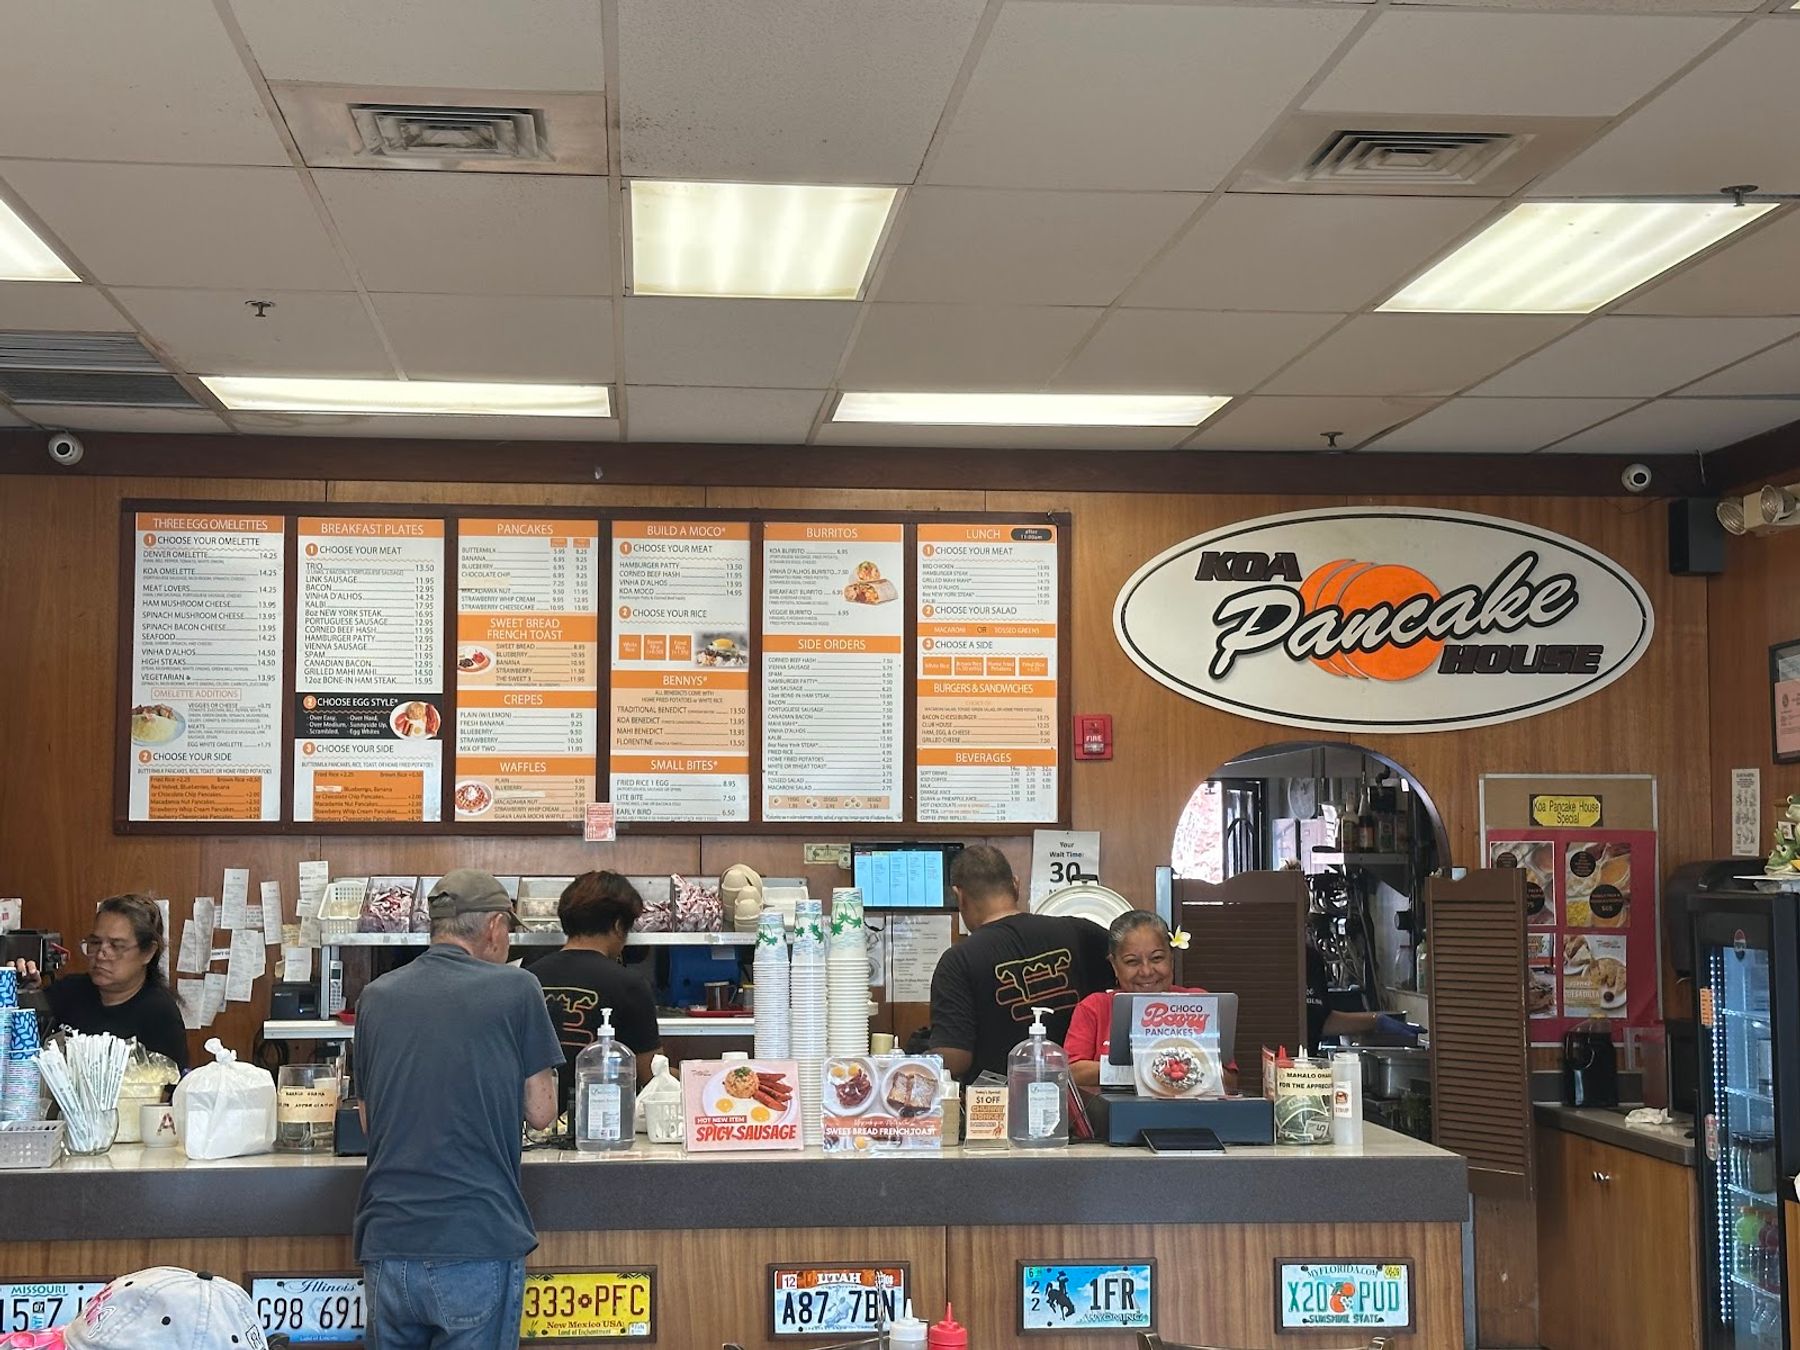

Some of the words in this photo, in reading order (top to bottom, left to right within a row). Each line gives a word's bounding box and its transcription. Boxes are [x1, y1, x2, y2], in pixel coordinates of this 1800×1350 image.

[153, 518, 186, 529] THREE
[187, 519, 208, 530] EGG
[209, 519, 268, 530] OMELETTES
[321, 523, 382, 535] BREAKFAST
[384, 524, 424, 535] PLATES
[497, 523, 554, 535] PANCAKES
[647, 525, 677, 536] BUILD
[679, 526, 687, 536] A
[806, 528, 858, 538] BURRITOS
[966, 529, 1000, 539] LUNCH
[157, 536, 191, 545] CHOOSE
[193, 536, 217, 545] YOUR
[218, 537, 260, 546] OMELETTE
[319, 546, 353, 554] CHOOSE
[355, 546, 377, 554] YOUR
[379, 546, 402, 555] MEAT
[633, 544, 666, 553] CHOOSE
[668, 545, 690, 553] YOUR
[691, 545, 712, 553] MEAT
[935, 546, 967, 555] CHOOSE
[968, 547, 990, 555] YOUR
[991, 547, 1013, 555] MEAT
[143, 551, 171, 559] DENVER
[172, 551, 208, 559] OMELETTE
[259, 552, 278, 560] 14.25
[1195, 551, 1303, 581] KOA
[159, 568, 195, 576] OMELETTE
[259, 569, 277, 577] 14.25
[319, 609, 339, 617] NEW
[339, 609, 358, 617] YORK
[632, 609, 665, 617] CHOOSE
[667, 609, 689, 618] YOUR
[690, 609, 707, 618] RICE
[934, 606, 967, 615] CHOOSE
[968, 606, 990, 615] YOUR
[991, 606, 1017, 615] SALAD
[1208, 550, 1579, 680] Pancake
[490, 618, 523, 628] SWEET
[526, 618, 560, 628] BREAD
[141, 633, 176, 641] SEAFOOD
[487, 629, 527, 640] FRENCH
[529, 629, 563, 640] TOAST
[798, 639, 821, 649] SIDE
[823, 639, 866, 650] ORDERS
[935, 640, 968, 649] CHOOSE
[968, 641, 975, 649] A
[976, 641, 993, 649] SIDE
[1438, 644, 1603, 674] HOUSE
[933, 682, 971, 693] BURGERS
[971, 683, 979, 693] &
[980, 683, 1034, 694] SANDWICHES
[153, 690, 194, 698] OMELETTE
[195, 690, 239, 698] ADDITIONS
[503, 694, 544, 705] CREPES
[317, 697, 351, 707] CHOOSE
[352, 697, 370, 707] EGG
[316, 745, 350, 753] CHOOSE
[352, 745, 375, 753] YOUR
[376, 745, 394, 753] SIDE
[152, 752, 187, 761] CHOOSE
[188, 752, 212, 761] YOUR
[213, 752, 232, 761] SIDE
[955, 752, 1012, 763] BEVERAGES
[500, 762, 547, 772] WAFFLES
[651, 760, 684, 770] SMALL
[1534, 801, 1546, 812] Koa
[1549, 800, 1577, 812] Pancake
[1579, 801, 1600, 812] House
[1557, 812, 1580, 824] Special
[1049, 861, 1081, 883] 30
[1170, 1004, 1203, 1013] CHOCO
[1145, 1028, 1193, 1036] PANCAKES
[976, 1096, 984, 1104] $1
[985, 1096, 1000, 1104] OFF
[157, 1112, 177, 1136] A
[696, 1126, 734, 1142] SPICY
[735, 1124, 797, 1140] SAUSAGE
[1307, 1265, 1379, 1278] MYFLORIDA.COM
[784, 1276, 796, 1287] 12
[816, 1273, 862, 1284] UTAH
[11, 1285, 66, 1294] MISSOURI
[293, 1280, 355, 1293] Illinois
[1090, 1278, 1135, 1311] 1FR
[1287, 1281, 1328, 1312] X20
[1359, 1281, 1400, 1312] PUD
[525, 1286, 575, 1318] 333
[595, 1284, 645, 1316] PFC
[782, 1291, 830, 1324] A87
[848, 1290, 896, 1323] 7BN
[257, 1297, 304, 1330] G98
[319, 1296, 365, 1329] 691
[1082, 1311, 1148, 1322] WYOMING
[547, 1321, 567, 1329] New
[568, 1321, 601, 1329] Mexico
[603, 1320, 623, 1328] USA
[1309, 1314, 1351, 1324] SUNSHINE
[1353, 1314, 1380, 1324] STATE
